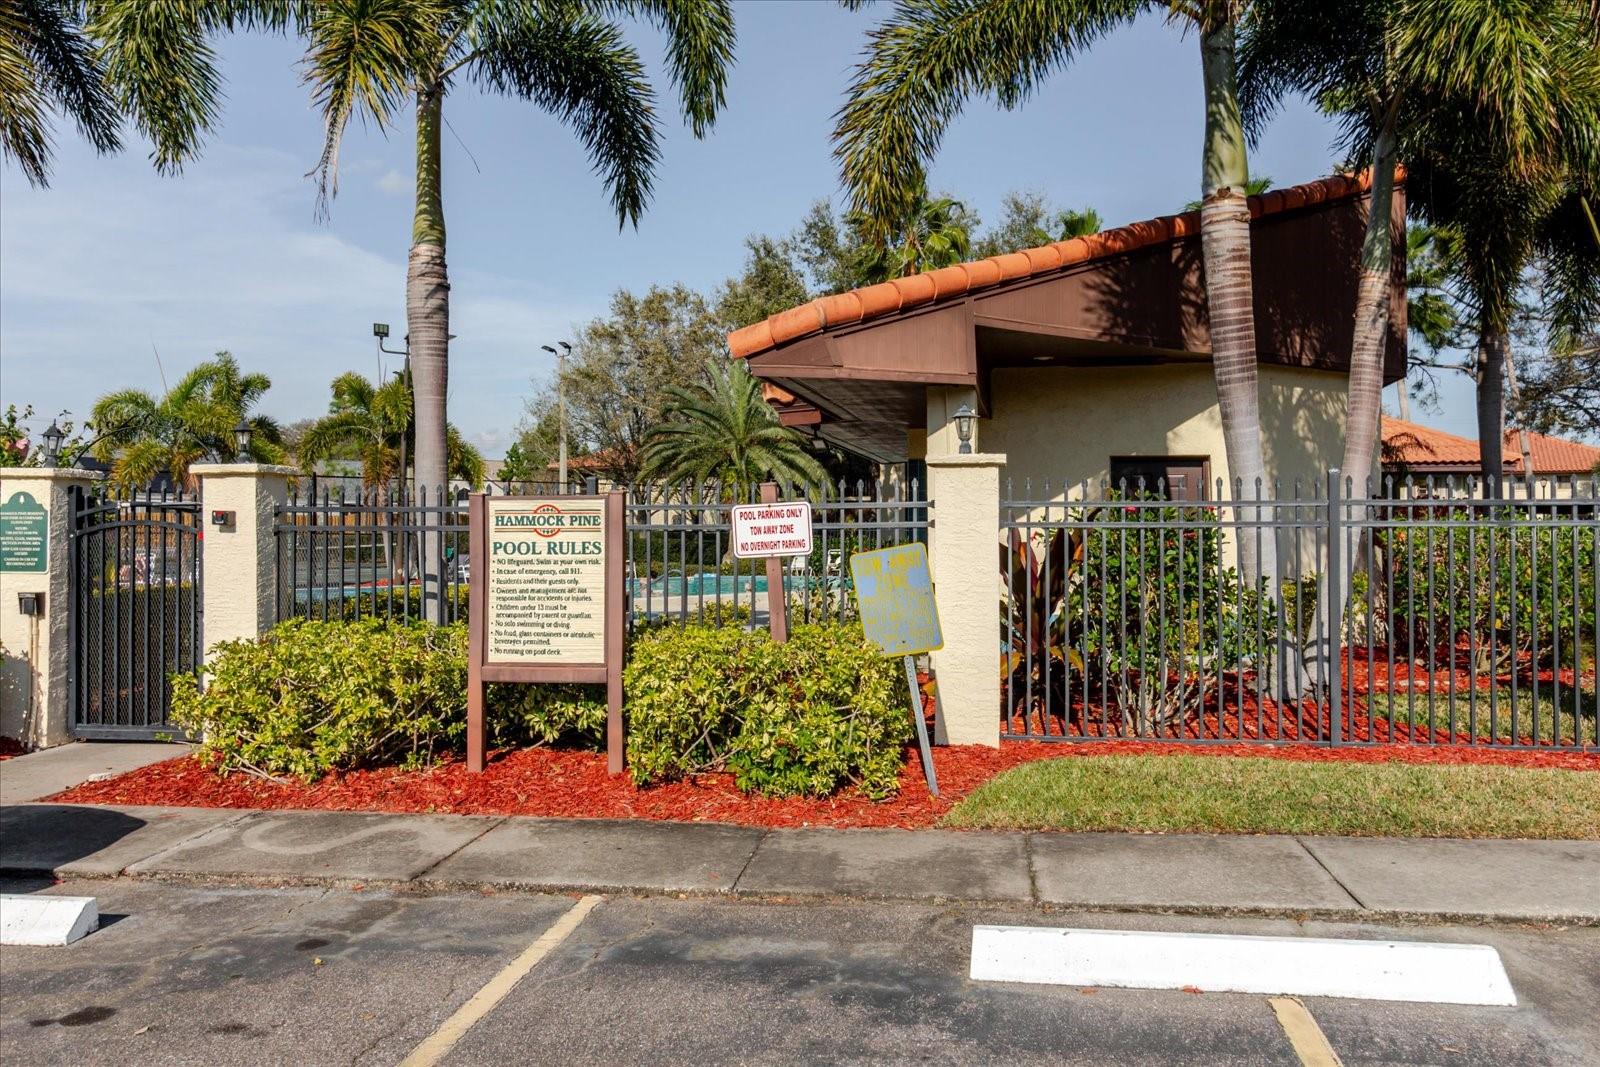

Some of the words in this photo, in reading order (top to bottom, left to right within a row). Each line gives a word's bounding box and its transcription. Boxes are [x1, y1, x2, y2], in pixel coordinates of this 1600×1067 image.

[740, 511, 756, 520] POOL
[758, 509, 784, 520] PARKING
[786, 508, 802, 518] ONLY
[495, 515, 566, 526] HAMMOCK
[569, 515, 601, 526] PINE
[750, 526, 762, 535] TOW
[764, 524, 778, 534] AWAY
[780, 524, 794, 534] ZONE
[492, 541, 542, 556] POOL
[546, 541, 602, 556] RULES
[740, 542, 749, 551] NO
[750, 540, 780, 551] OVERNIGHT
[782, 539, 806, 549] PARKING
[534, 612, 540, 620] by
